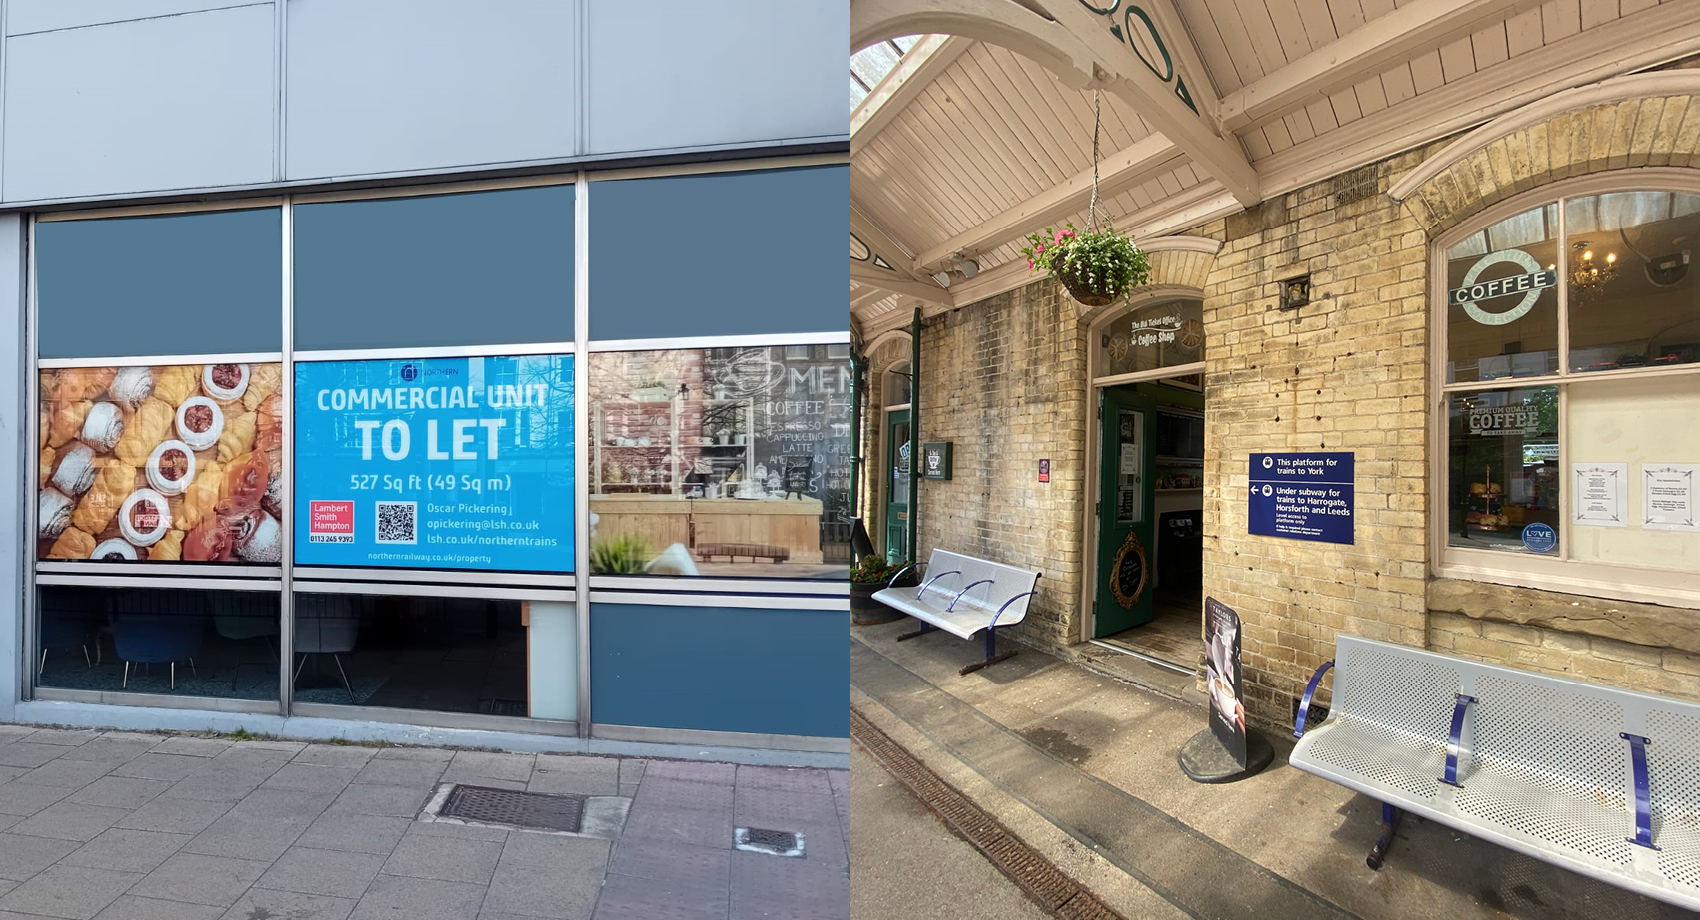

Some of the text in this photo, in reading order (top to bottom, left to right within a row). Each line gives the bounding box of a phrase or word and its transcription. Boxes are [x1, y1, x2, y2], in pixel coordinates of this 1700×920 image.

[1456, 272, 1546, 302] COFFEE
[1466, 293, 1537, 324] COLLECTION
[1138, 331, 1175, 346] Coffee Shop
[422, 368, 459, 376] NORTHERN
[317, 383, 550, 411] COMMERCIAL UNIT
[766, 400, 824, 415] COFFEE
[1469, 412, 1539, 428] COFFEE
[770, 421, 821, 432] ESPRESSO
[354, 418, 506, 460] TO LET
[767, 432, 824, 443] CAPPUCCINO
[783, 444, 813, 453] LATTE
[1292, 459, 1324, 467] platform
[350, 474, 512, 494] 527 Sq ft (49 Sq m)
[1298, 488, 1327, 498] subway
[1307, 497, 1347, 507] Harrogate,
[314, 504, 348, 512] Lambert
[427, 503, 507, 515] Oscar Pickering
[1276, 504, 1309, 513] Horsforth
[1328, 507, 1350, 516] Leeds
[314, 521, 350, 531] Hampton
[427, 519, 539, 530] opickering@lsh.co.uk
[427, 535, 557, 546] lsh.co.uk/northerntrains
[368, 552, 491, 563] northernrailway.co.uk/property
